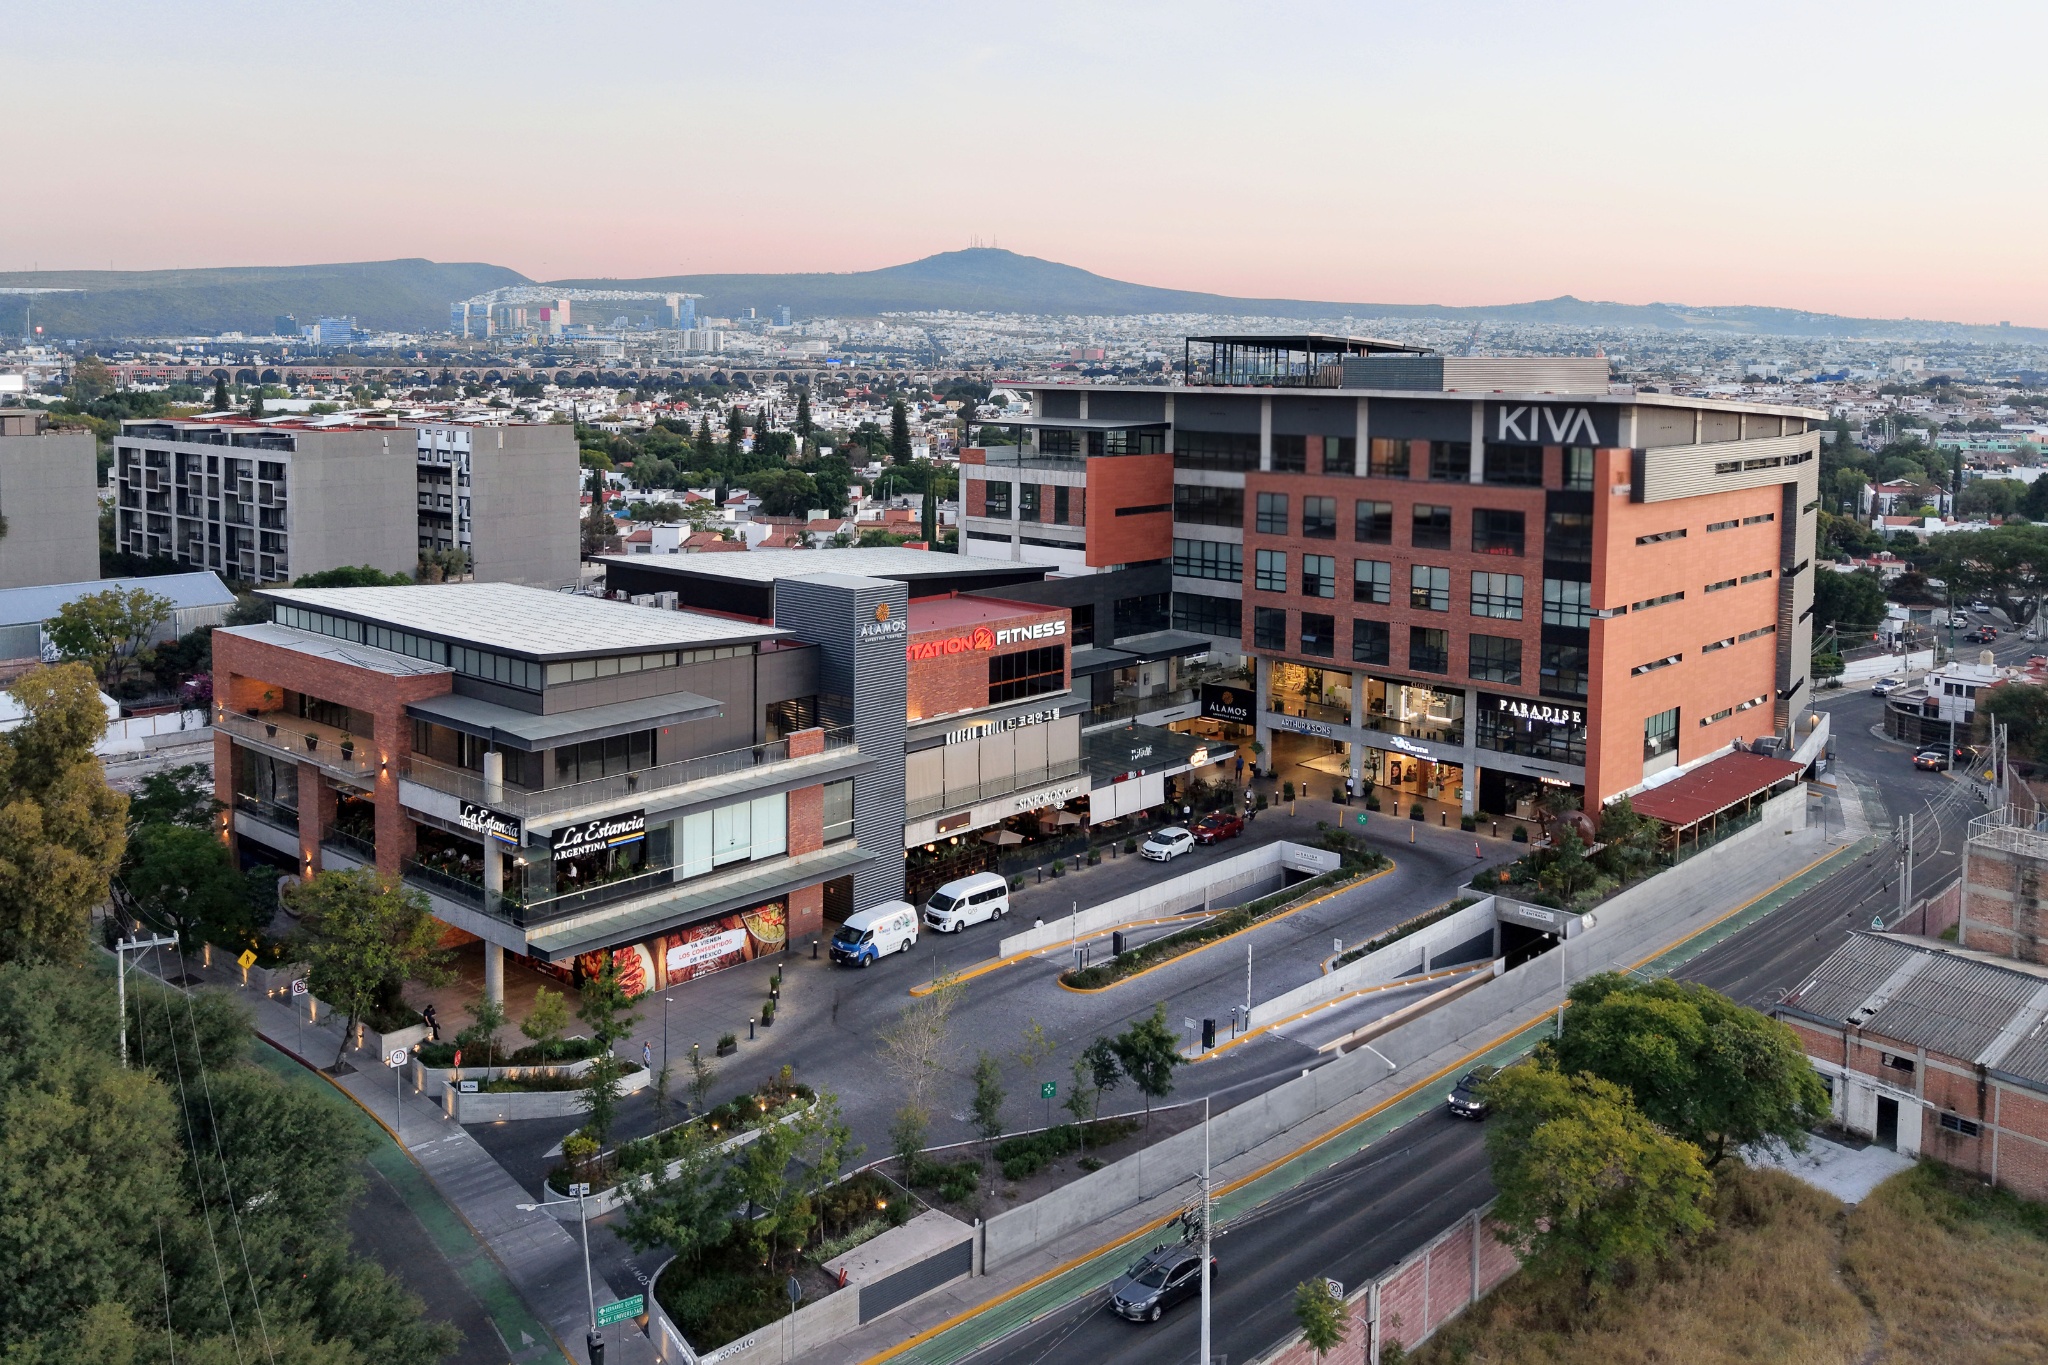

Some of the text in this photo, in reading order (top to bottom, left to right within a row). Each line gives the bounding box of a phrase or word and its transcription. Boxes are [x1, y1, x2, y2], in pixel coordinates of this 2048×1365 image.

[1498, 406, 1600, 444] KIVA
[974, 627, 995, 651] 24
[996, 620, 1066, 646] FITNESS
[1209, 701, 1247, 717] ÁLAMOS
[1500, 699, 1581, 723] PARADISE
[946, 720, 1005, 746] KOREAN GRILL
[1019, 788, 1068, 810] SINFOROSA
[459, 805, 519, 838] La Estancia
[553, 815, 645, 850] La Estancia
[553, 840, 607, 861] ARGENTINA
[678, 938, 733, 960] LOS CONSENTIDOS
[699, 935, 722, 946] VIENEN
[1330, 1284, 1339, 1293] 30
